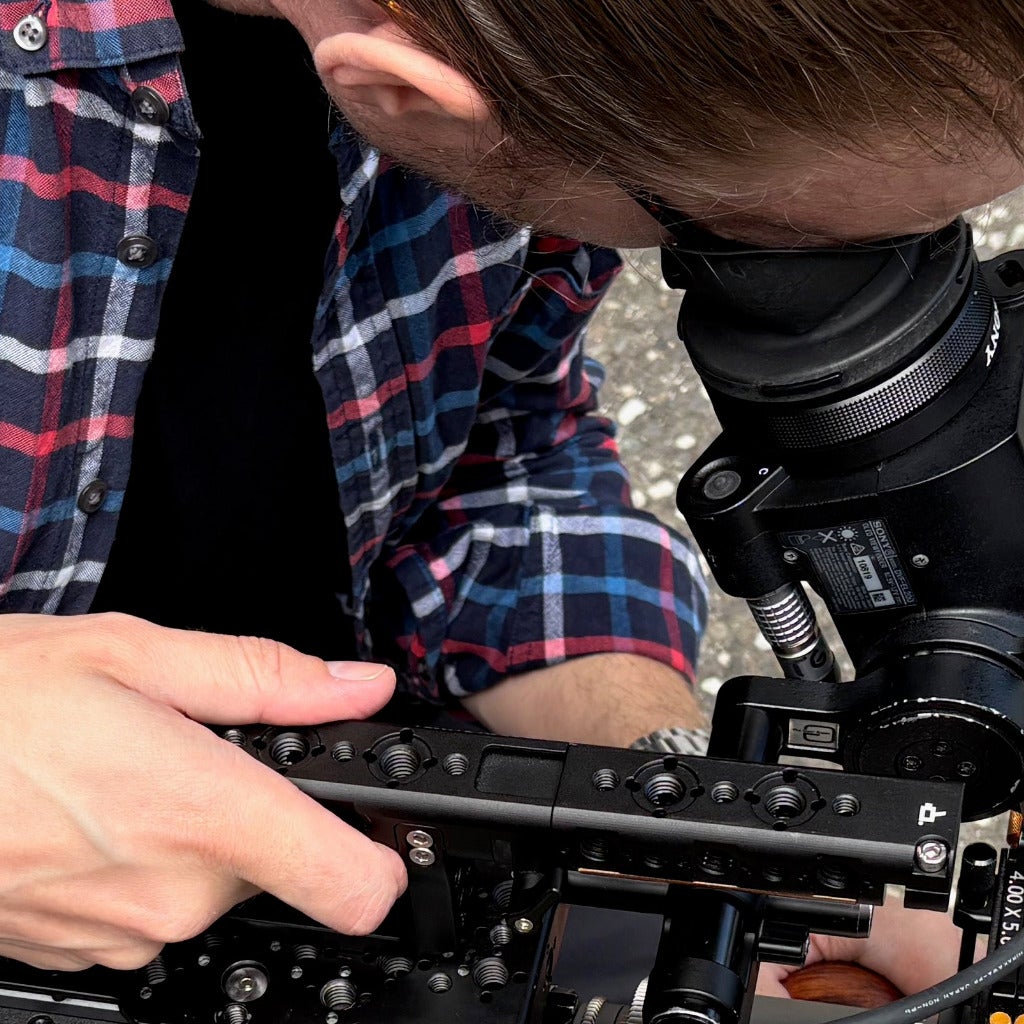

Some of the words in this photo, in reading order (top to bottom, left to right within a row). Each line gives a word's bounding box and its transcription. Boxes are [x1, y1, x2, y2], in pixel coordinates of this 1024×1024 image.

[872, 521, 892, 551] SONY
[1007, 870, 1024, 904] 4.00
[944, 983, 970, 999] JAPAN
